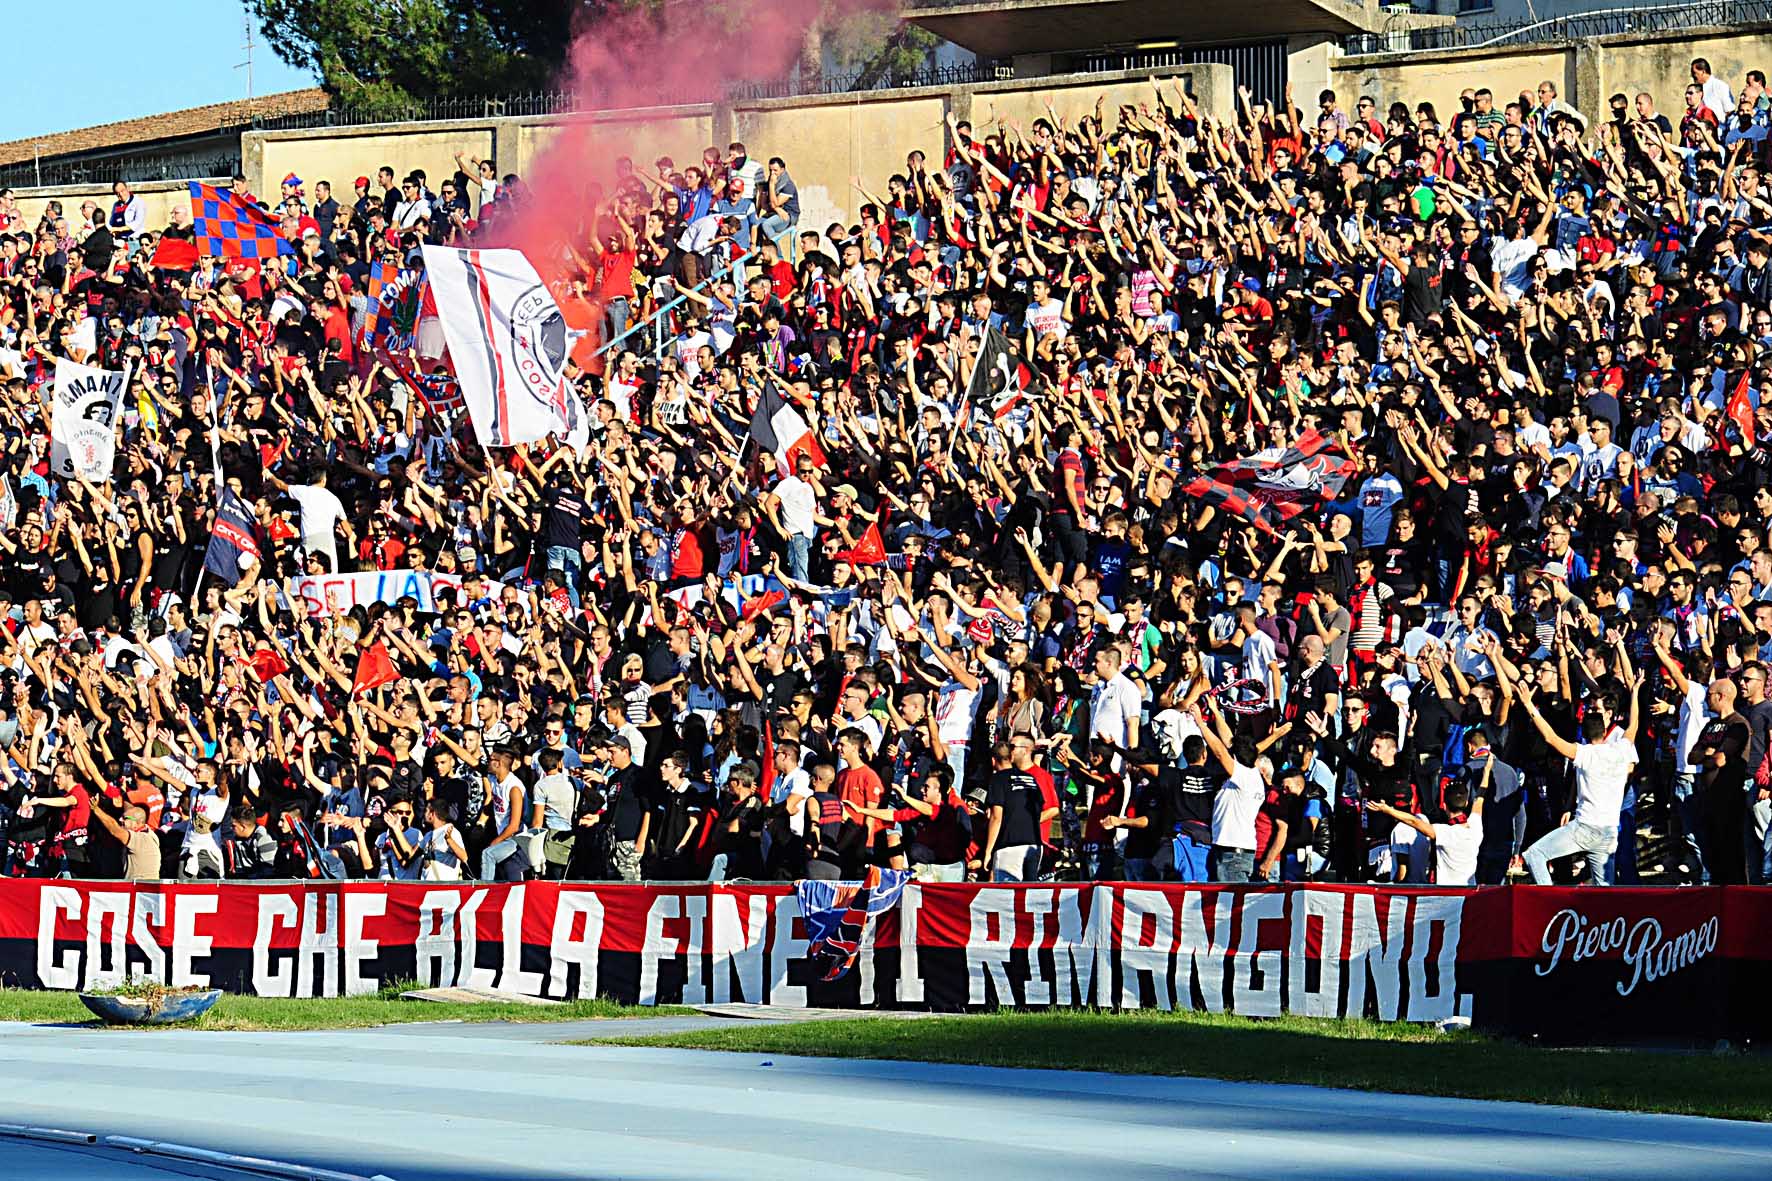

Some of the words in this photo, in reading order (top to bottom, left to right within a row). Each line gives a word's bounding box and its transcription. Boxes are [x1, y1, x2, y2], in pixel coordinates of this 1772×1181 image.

[300, 578, 356, 615] SEI
[36, 885, 220, 991] COSE
[252, 892, 388, 998] CHE
[415, 883, 606, 1000] ALLA
[639, 893, 808, 1008] FINE
[1535, 908, 1626, 976] Piero
[1616, 915, 1719, 996] Romeo
